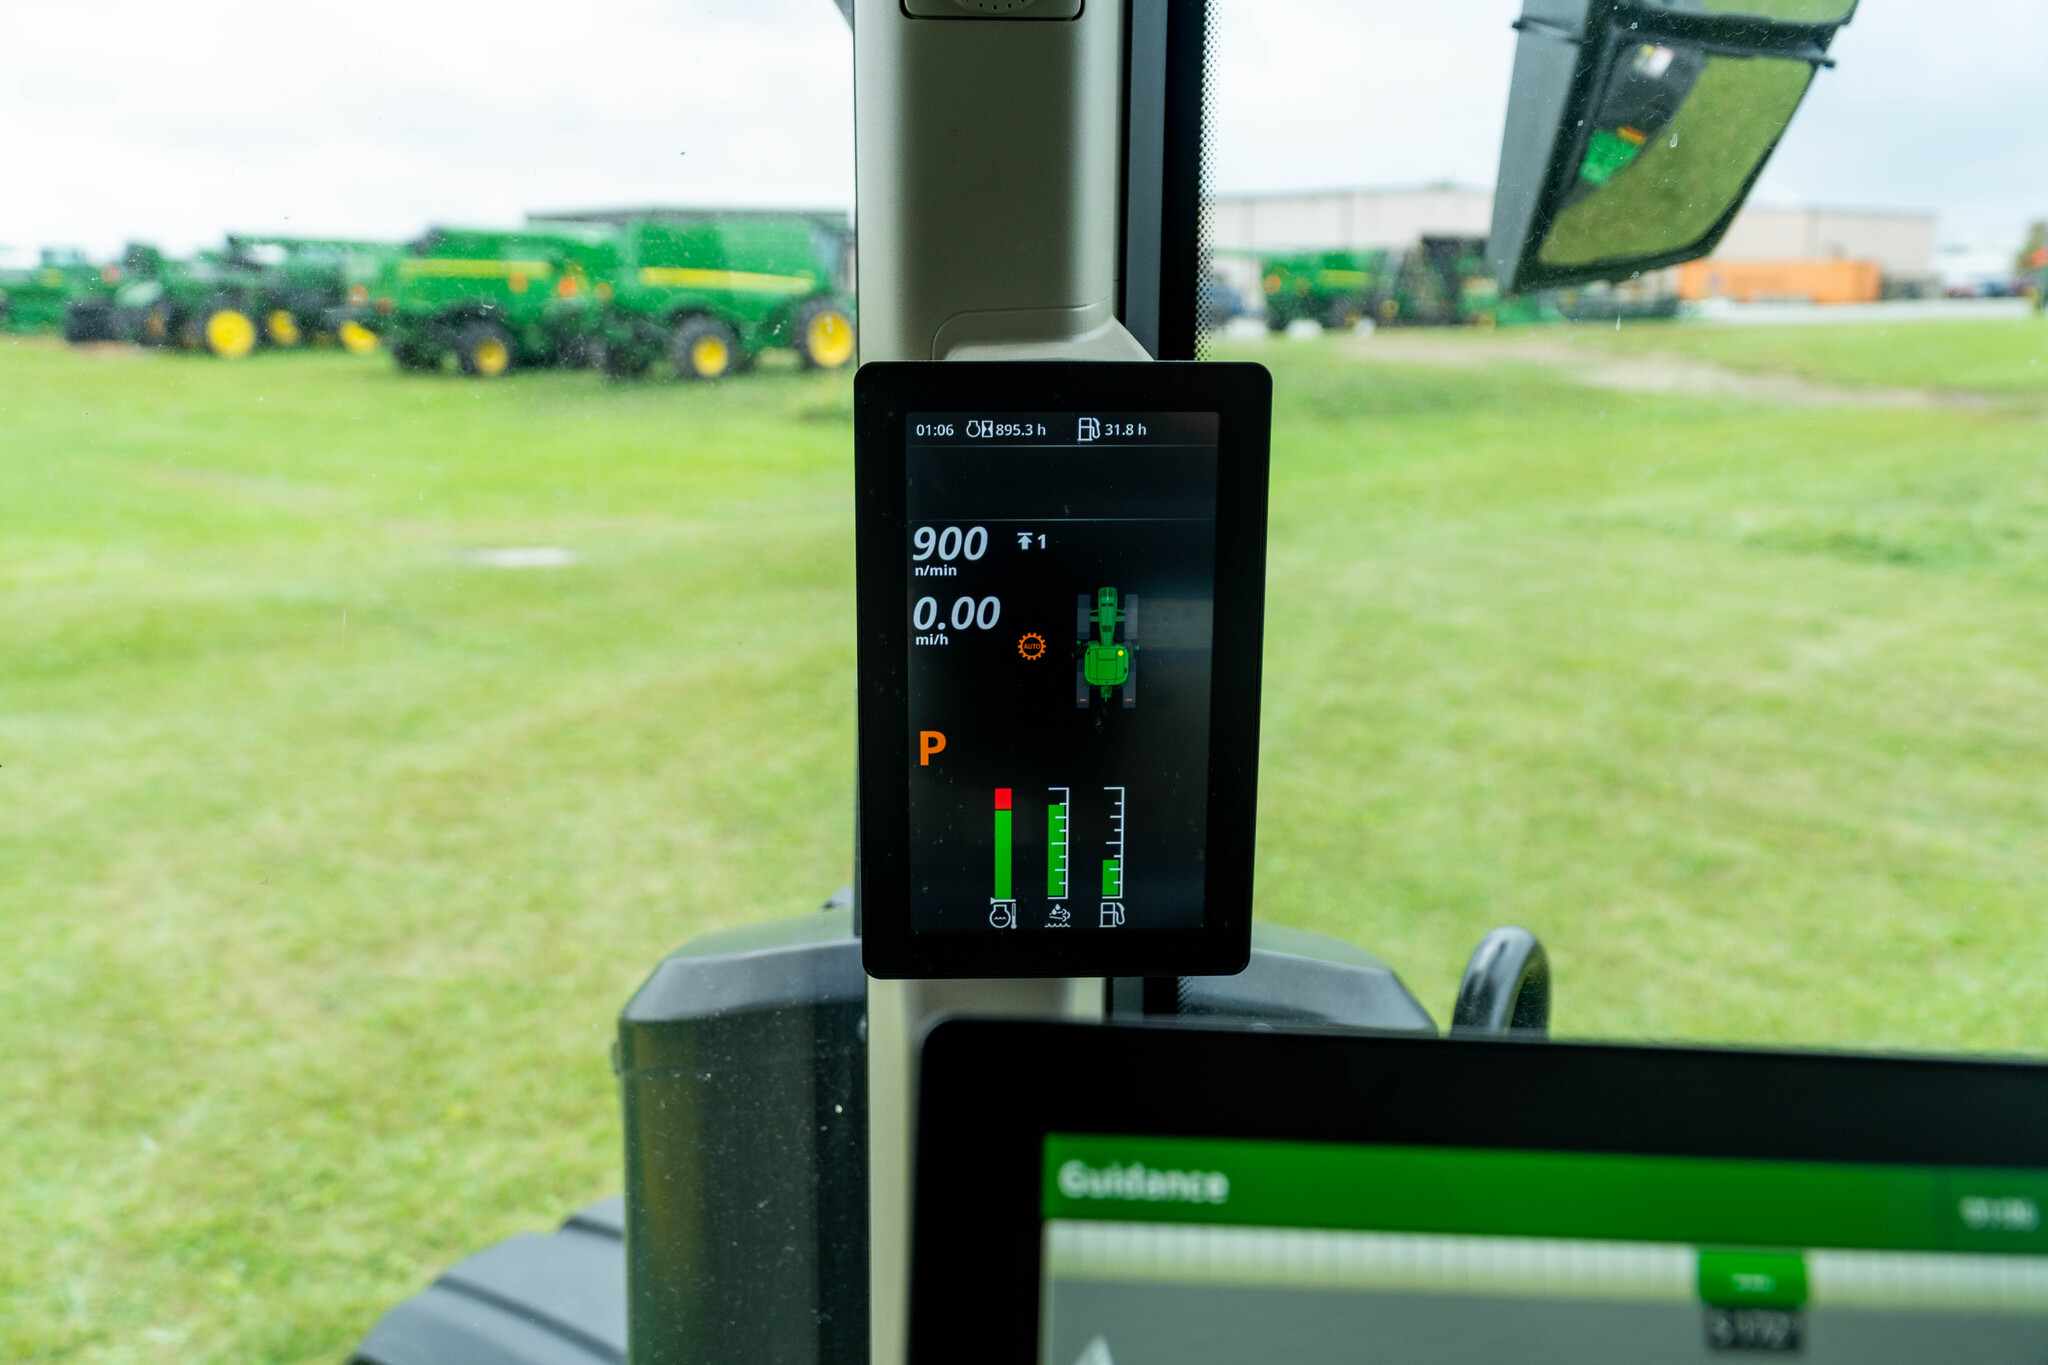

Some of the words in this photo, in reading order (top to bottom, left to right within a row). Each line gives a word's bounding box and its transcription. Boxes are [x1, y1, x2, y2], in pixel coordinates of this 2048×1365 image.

[915, 423, 954, 436] 01:06
[995, 423, 1034, 436] 895.3
[1037, 423, 1046, 436] h
[1104, 423, 1134, 436] 31.8
[1138, 423, 1147, 436] h
[912, 526, 988, 561] 900
[1037, 534, 1046, 549] 1
[915, 564, 957, 577] n/min
[913, 596, 1001, 630] 0.00
[915, 633, 949, 646] mi/h
[919, 730, 947, 766] P
[1058, 1160, 1230, 1204] Guidance
